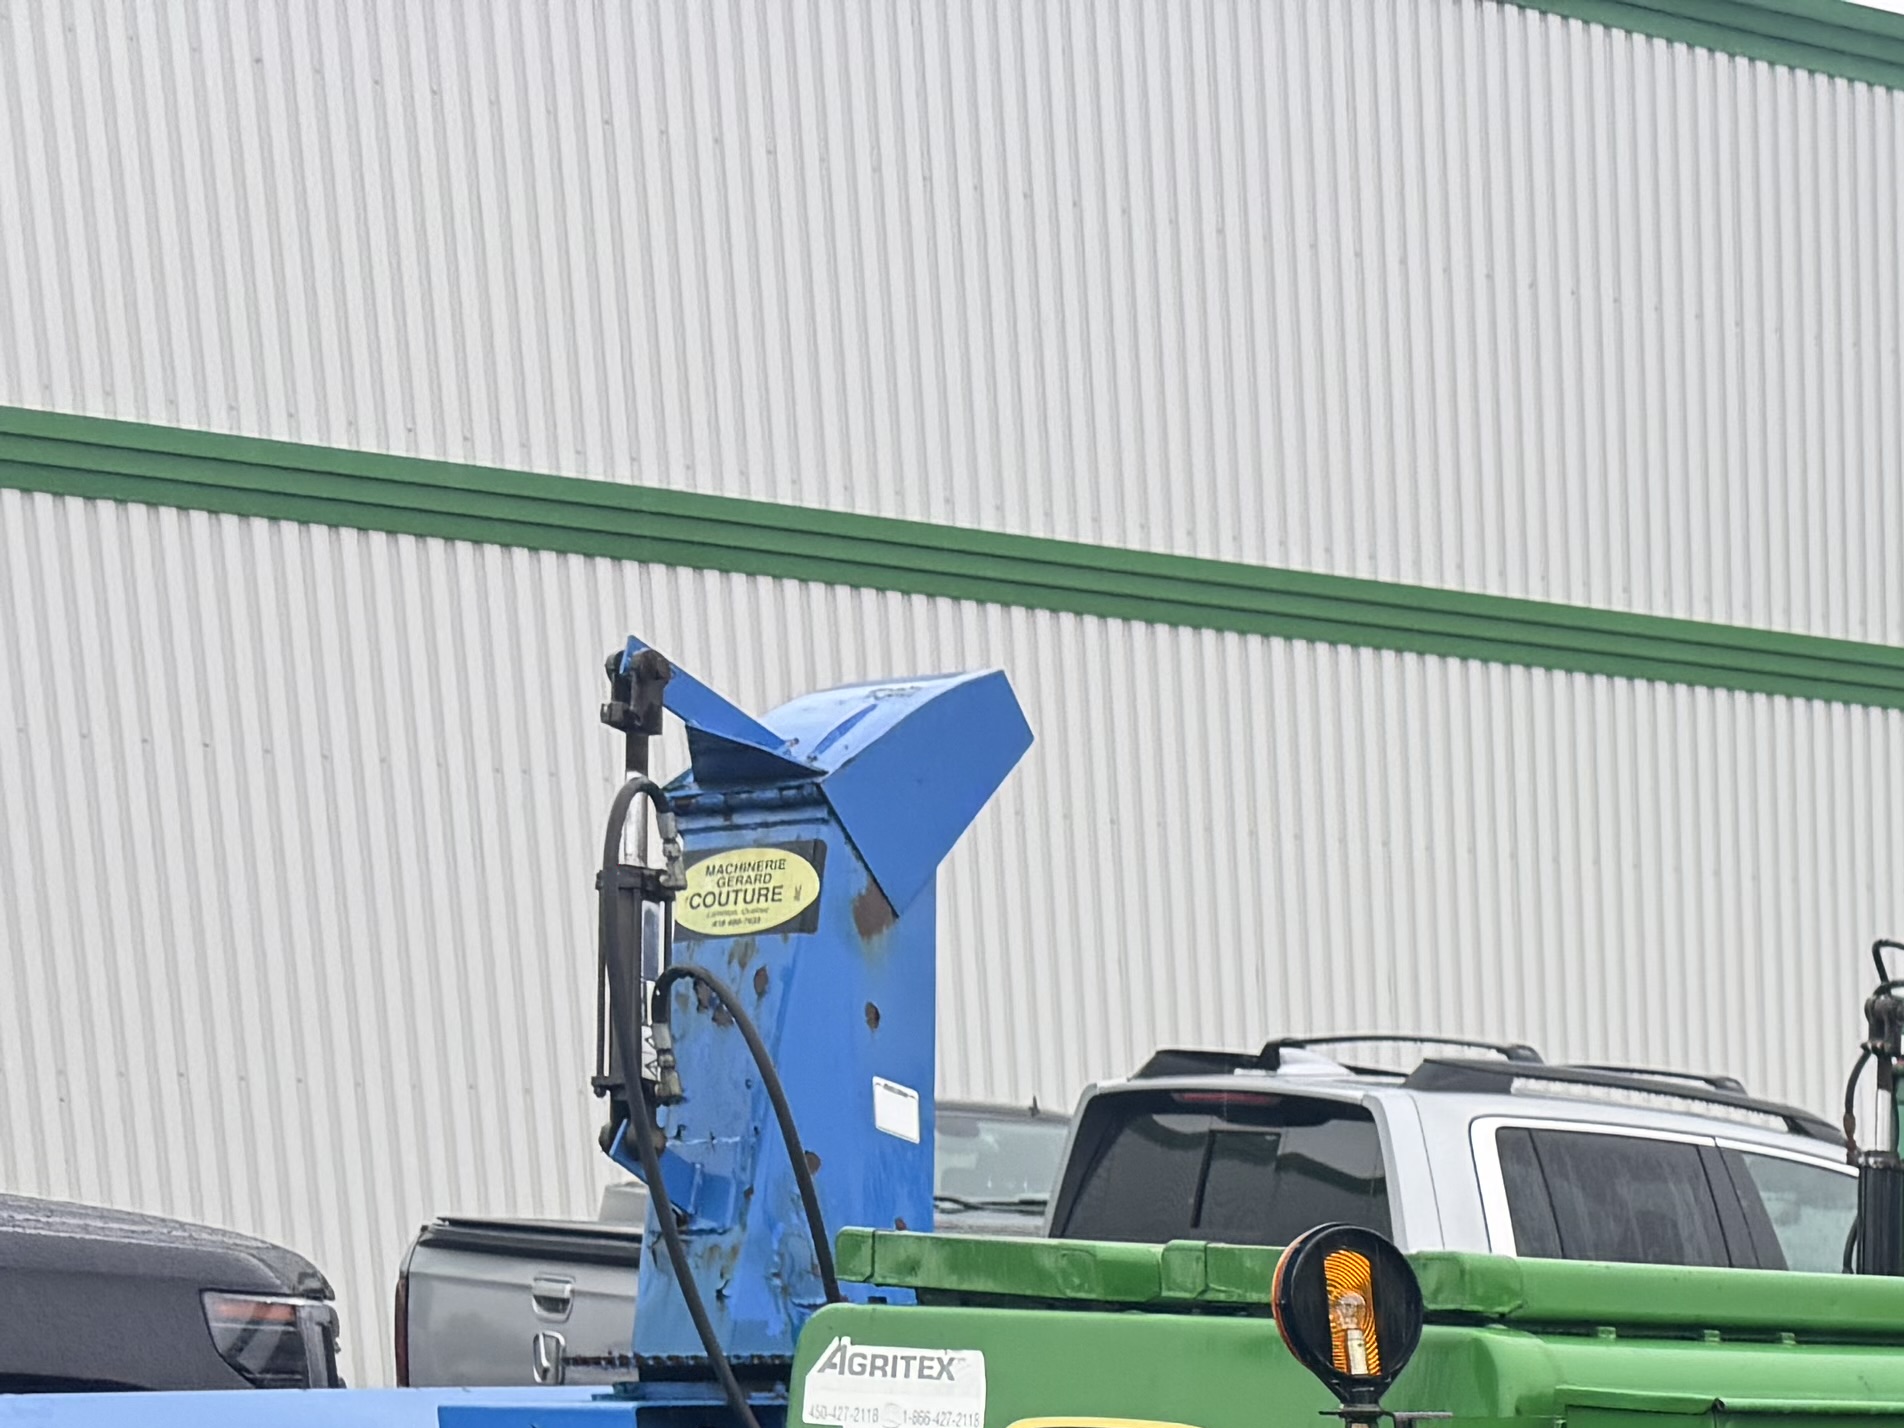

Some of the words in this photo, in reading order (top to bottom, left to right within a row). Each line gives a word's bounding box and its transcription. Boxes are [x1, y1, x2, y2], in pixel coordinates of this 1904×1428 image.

[705, 859, 787, 877] MACHINERIE
[716, 873, 773, 889] GERARD
[688, 884, 784, 910] COUTURE
[817, 1344, 956, 1382] AGRITEX
[808, 1404, 880, 1423] 450-427-2118
